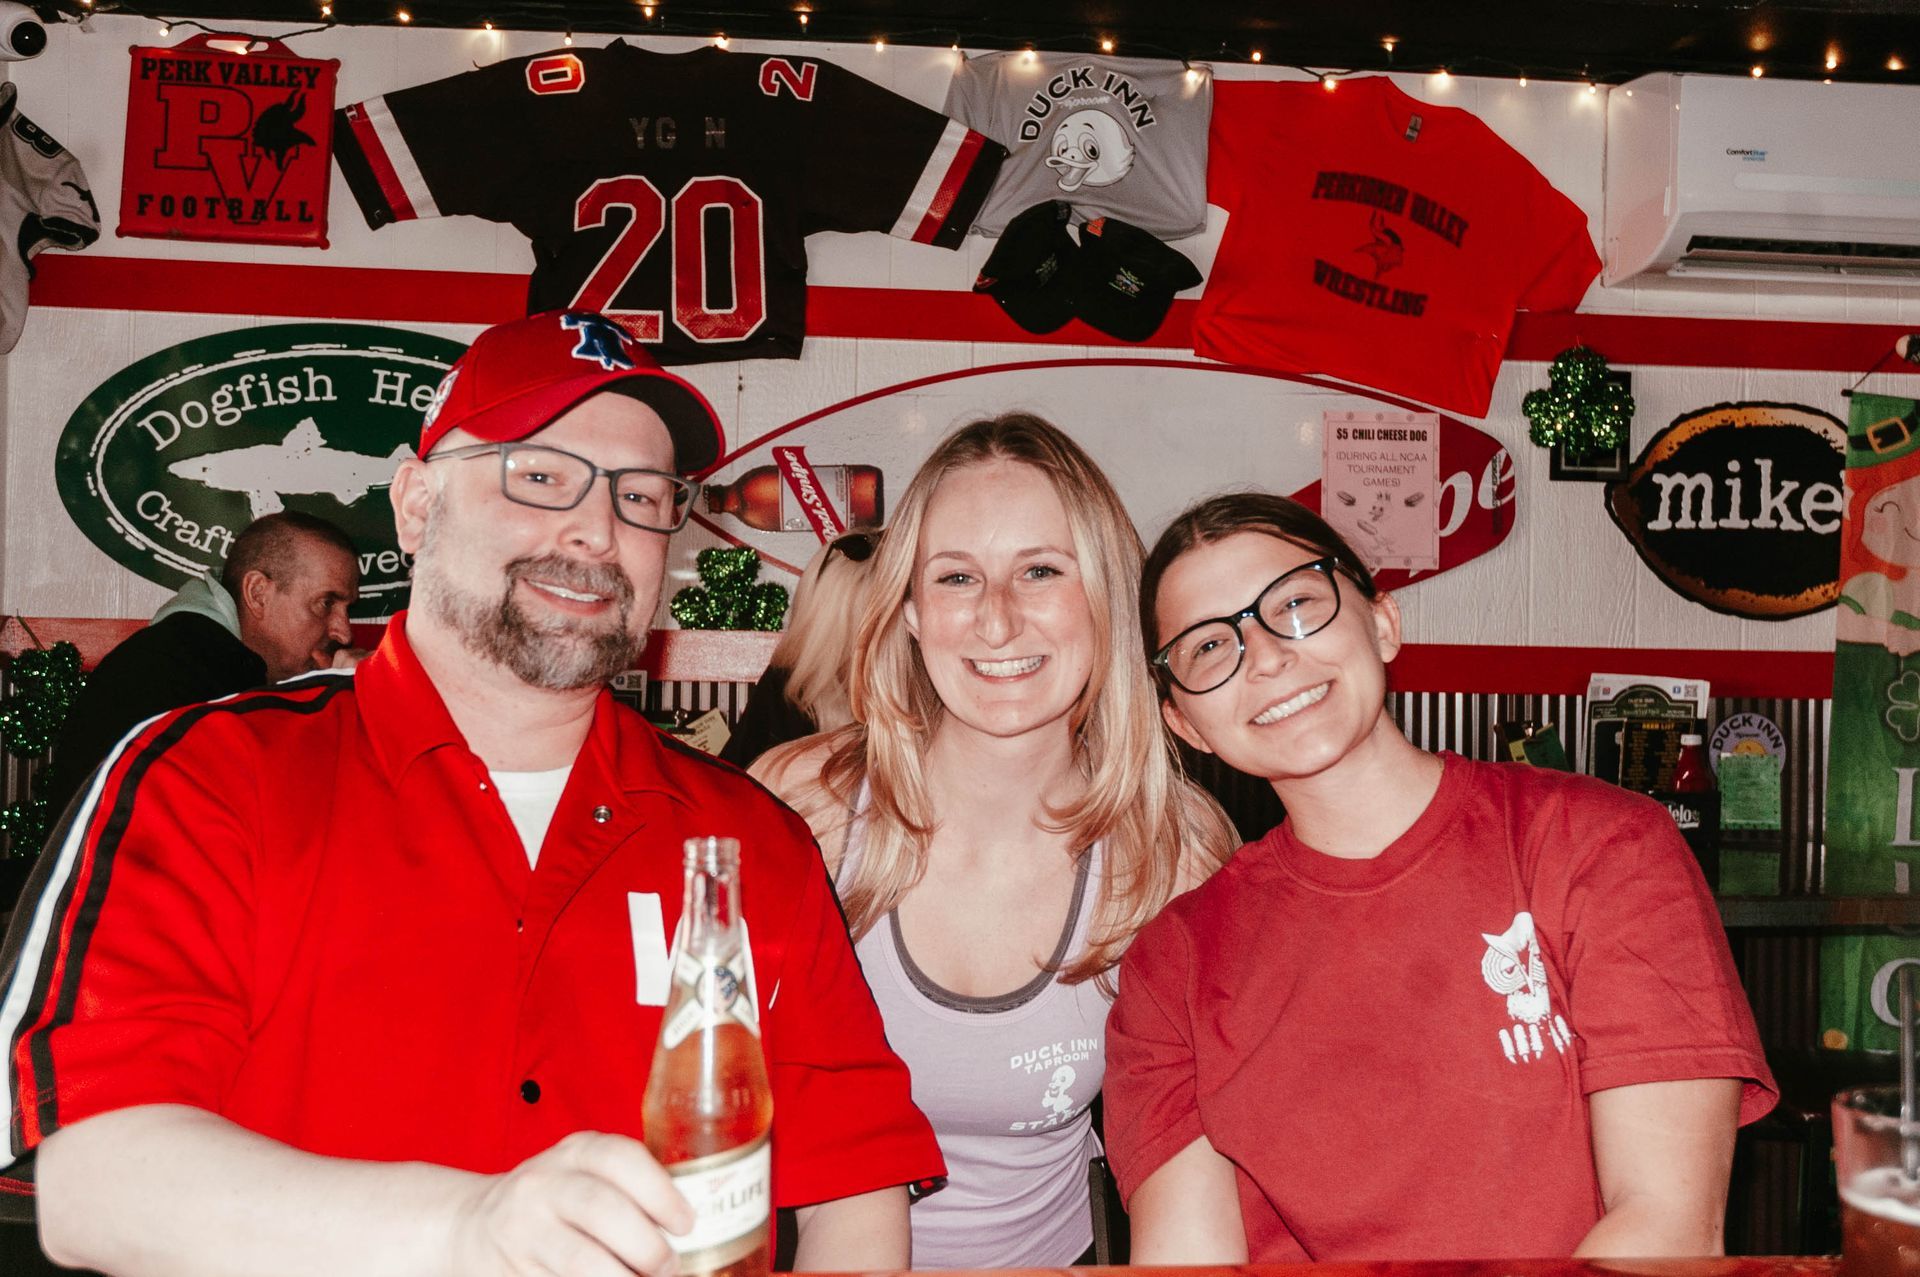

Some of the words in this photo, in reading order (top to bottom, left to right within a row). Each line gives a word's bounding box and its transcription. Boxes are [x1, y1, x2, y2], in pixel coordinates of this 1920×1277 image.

[140, 57, 212, 83] PERK
[219, 61, 321, 89] VALLEY
[1019, 66, 1096, 142] DUCK
[1100, 71, 1157, 132] INN
[137, 194, 314, 223] FOOTBALL
[1410, 192, 1469, 248] VALLEY
[567, 174, 766, 343] 20
[1313, 258, 1428, 317] WRESTLING
[137, 366, 338, 451] Dogfish
[368, 368, 436, 412] He
[1336, 428, 1349, 440] $5
[1352, 428, 1375, 441] CHILI
[1377, 429, 1408, 442] CHEESE
[1409, 430, 1428, 442] DOG
[1347, 463, 1417, 474] TOURNAMENT
[1379, 452, 1398, 462] ALL
[1400, 452, 1428, 462] NCAA
[1647, 458, 1844, 534] mike
[136, 490, 236, 558] Craft
[1712, 715, 1753, 751] DUCK
[1757, 718, 1783, 749] INN
[1010, 1042, 1064, 1069] DUCK
[1070, 1038, 1098, 1052] INN
[1024, 1051, 1089, 1074] TAPROOM
